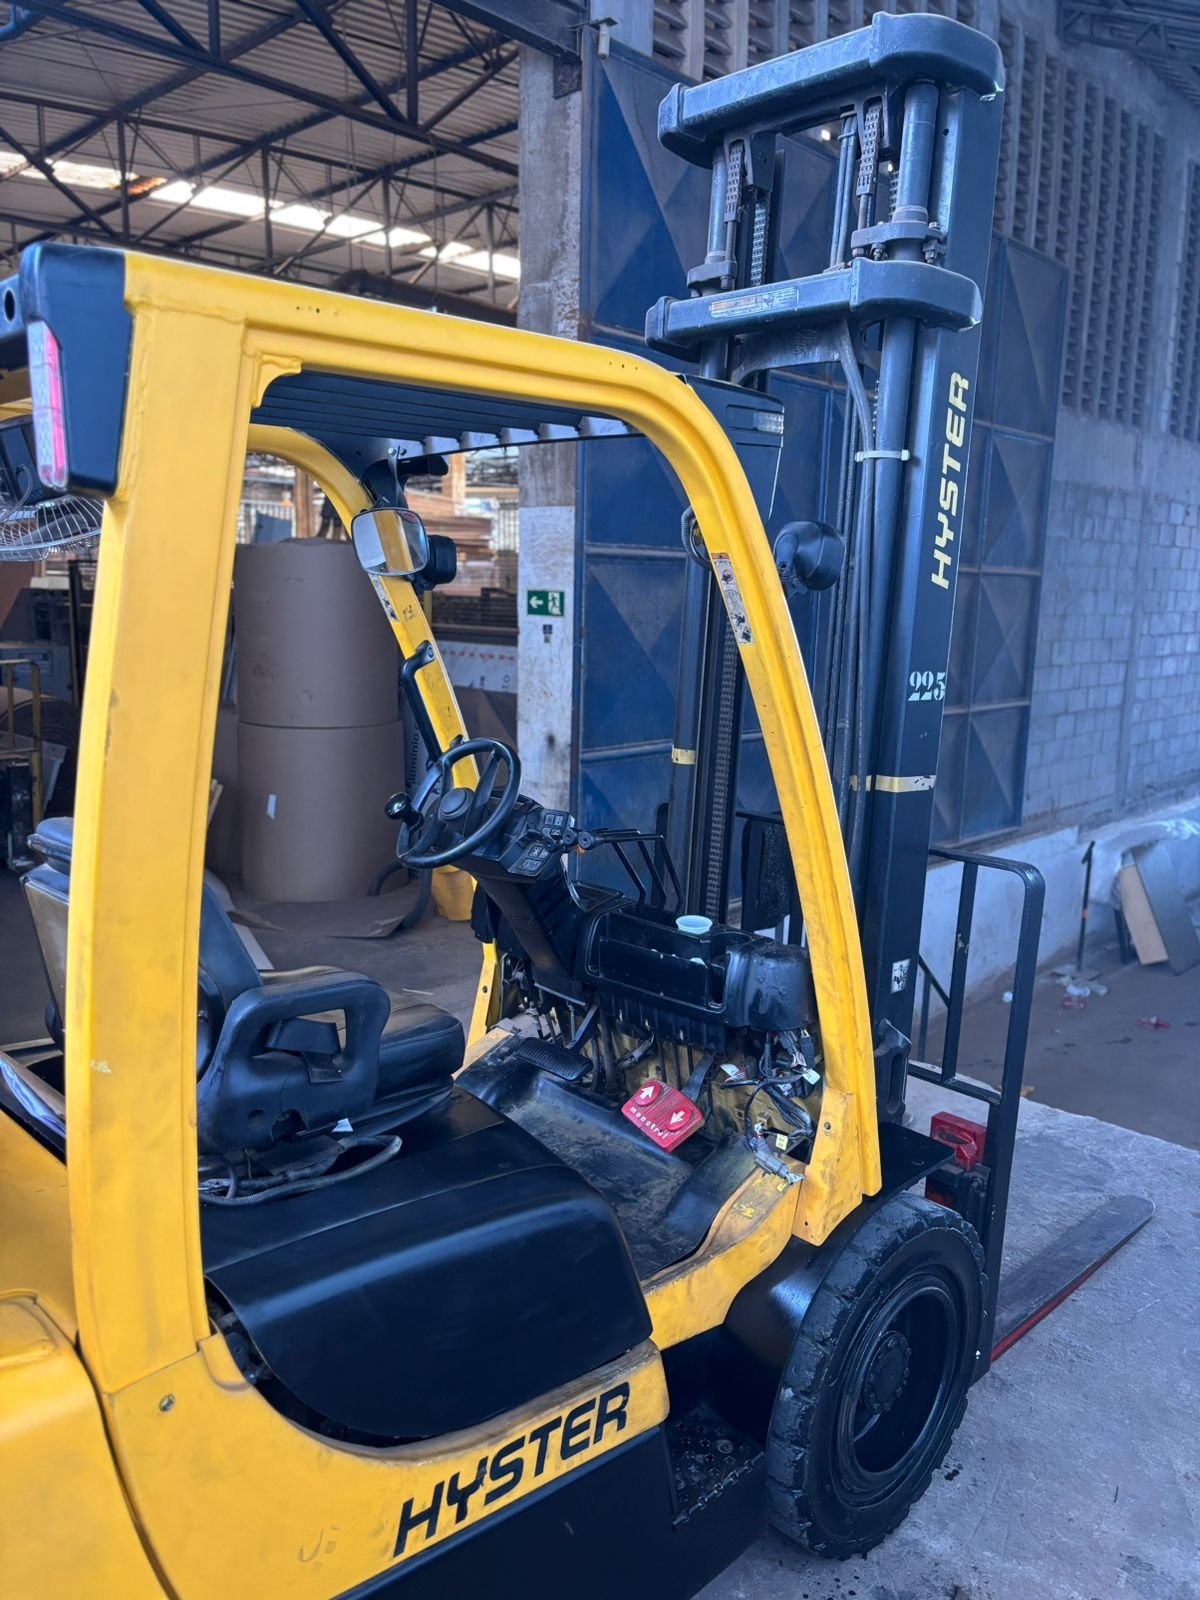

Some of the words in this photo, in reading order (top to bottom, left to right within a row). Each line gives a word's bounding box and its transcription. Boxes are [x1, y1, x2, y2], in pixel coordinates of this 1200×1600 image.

[931, 371, 969, 590] HYSTER
[908, 671, 946, 701] 225
[393, 1381, 631, 1559] HYSTER
